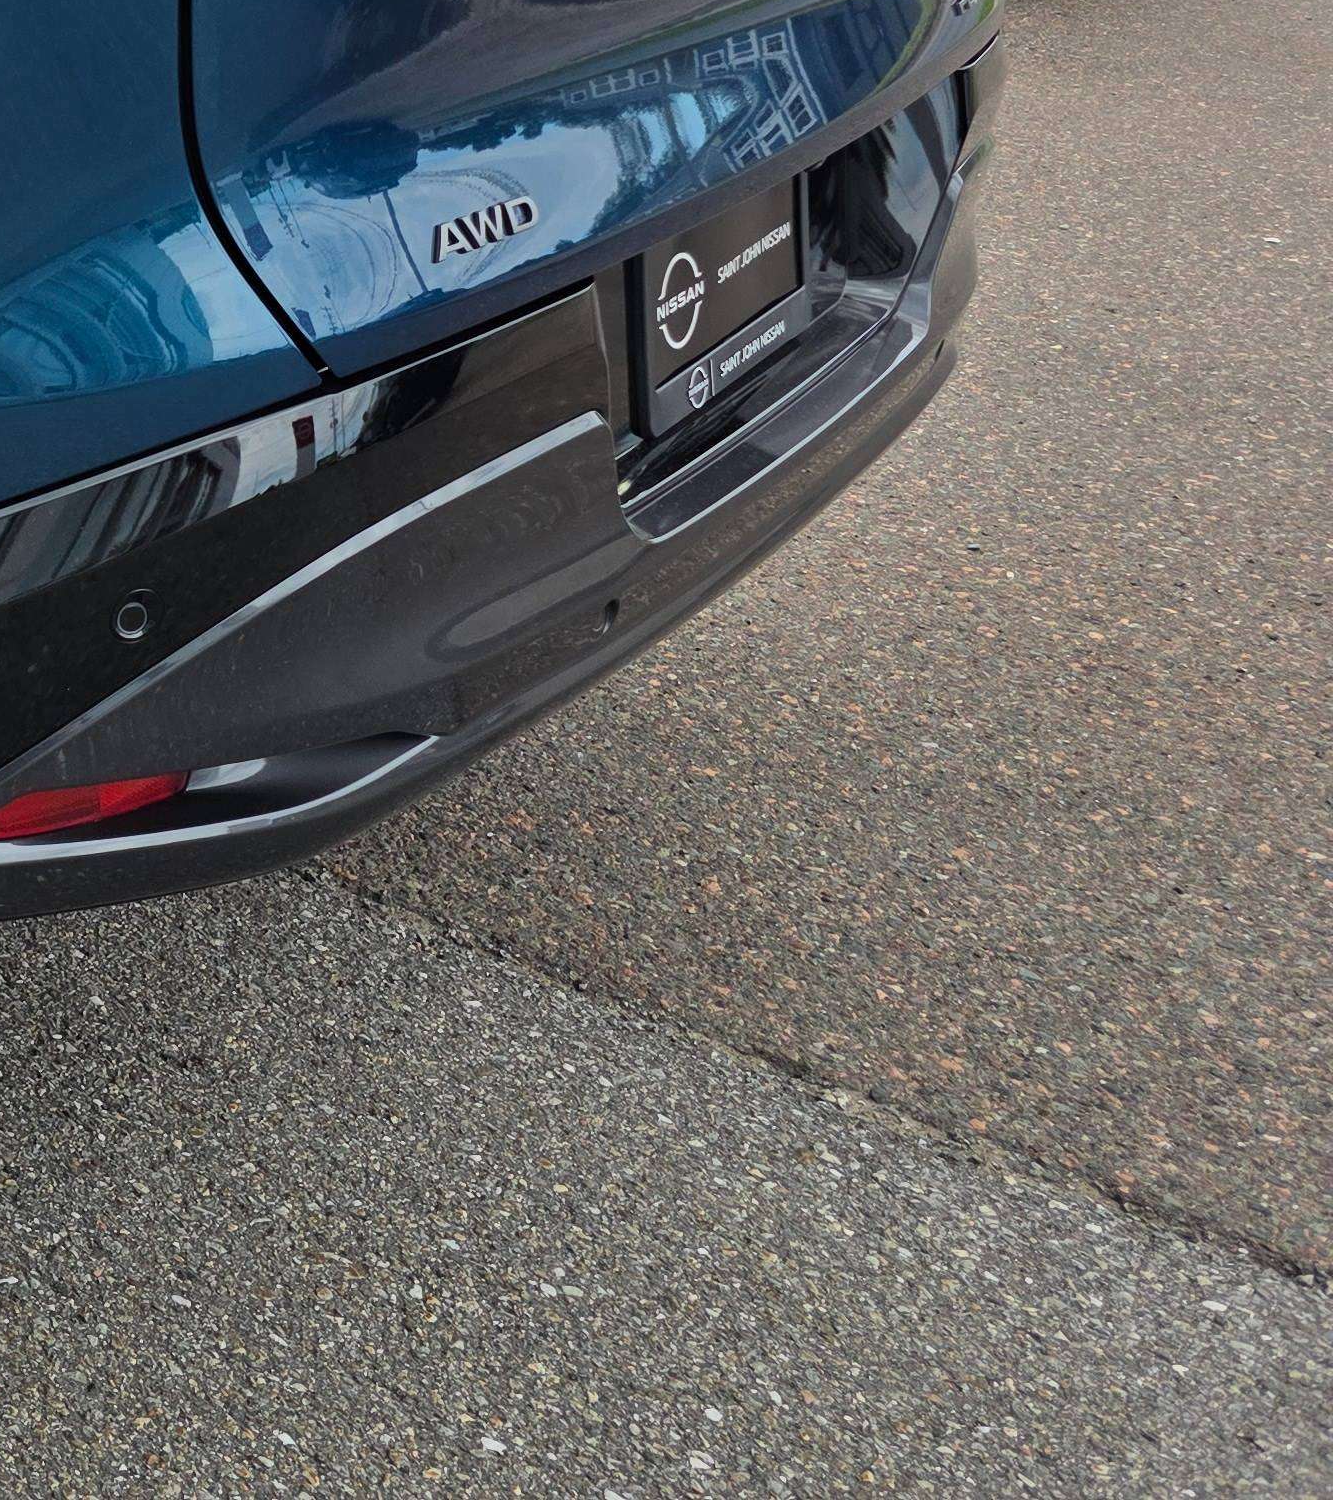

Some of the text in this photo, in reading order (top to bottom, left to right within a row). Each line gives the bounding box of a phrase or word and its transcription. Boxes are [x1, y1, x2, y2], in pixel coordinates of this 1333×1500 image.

[431, 195, 539, 264] AWD
[717, 221, 791, 284] SAINT JOHN NISSAN
[656, 280, 705, 322] NISSAN
[720, 320, 786, 377] SAINT JOHN NISSAN
